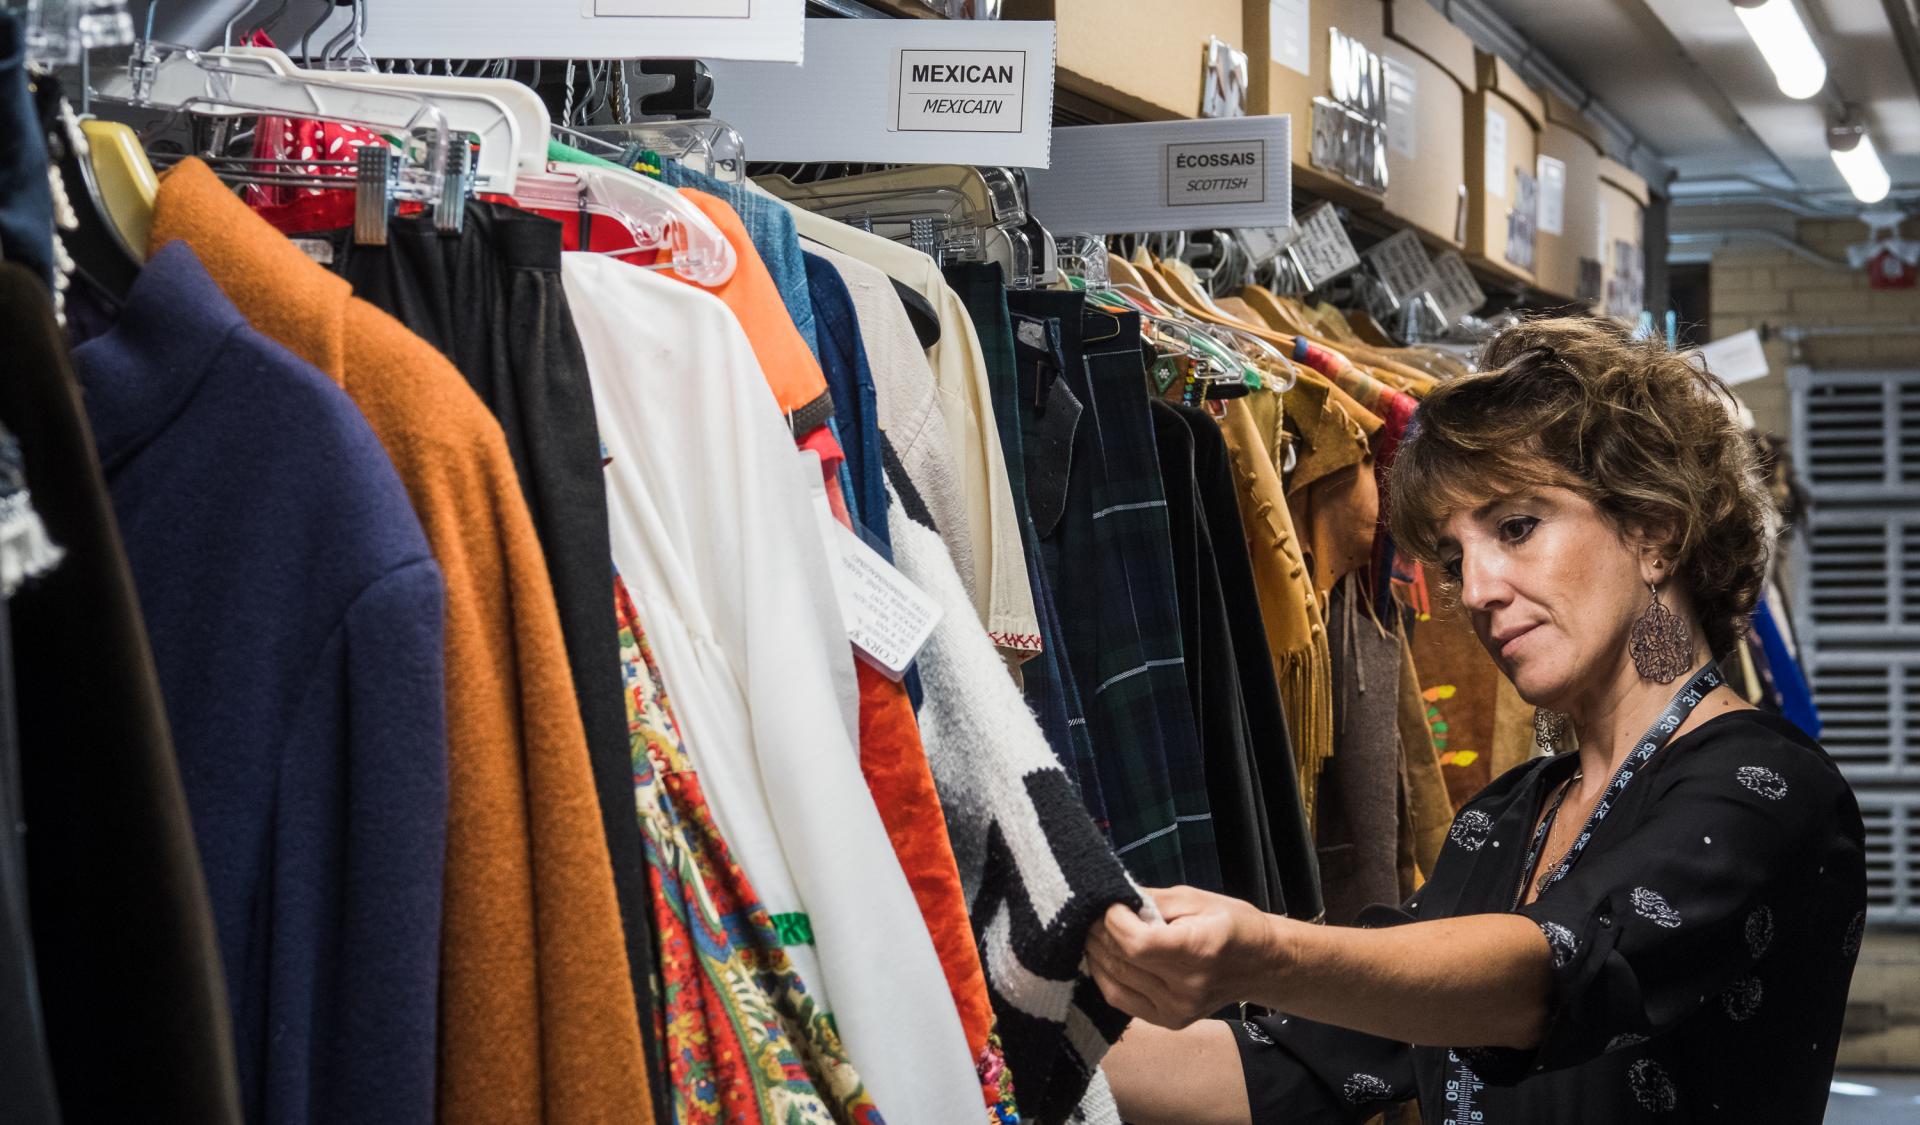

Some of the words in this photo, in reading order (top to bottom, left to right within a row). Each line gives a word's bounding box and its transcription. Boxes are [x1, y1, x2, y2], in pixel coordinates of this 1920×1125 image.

[912, 64, 1013, 83] MEXICAN
[922, 99, 1003, 114] MEXICAIN
[1176, 152, 1256, 169] ÉCOSSAIS
[1186, 177, 1249, 192] SCOTTISH
[1704, 672, 1719, 687] 32
[1682, 688, 1702, 707] 31
[1660, 715, 1681, 733] 30
[1637, 742, 1656, 760] 29
[1615, 770, 1633, 789] 28
[1595, 801, 1610, 819] 27
[1574, 832, 1591, 851] 26
[1554, 864, 1569, 881] 25
[1445, 1080, 1460, 1101] 50
